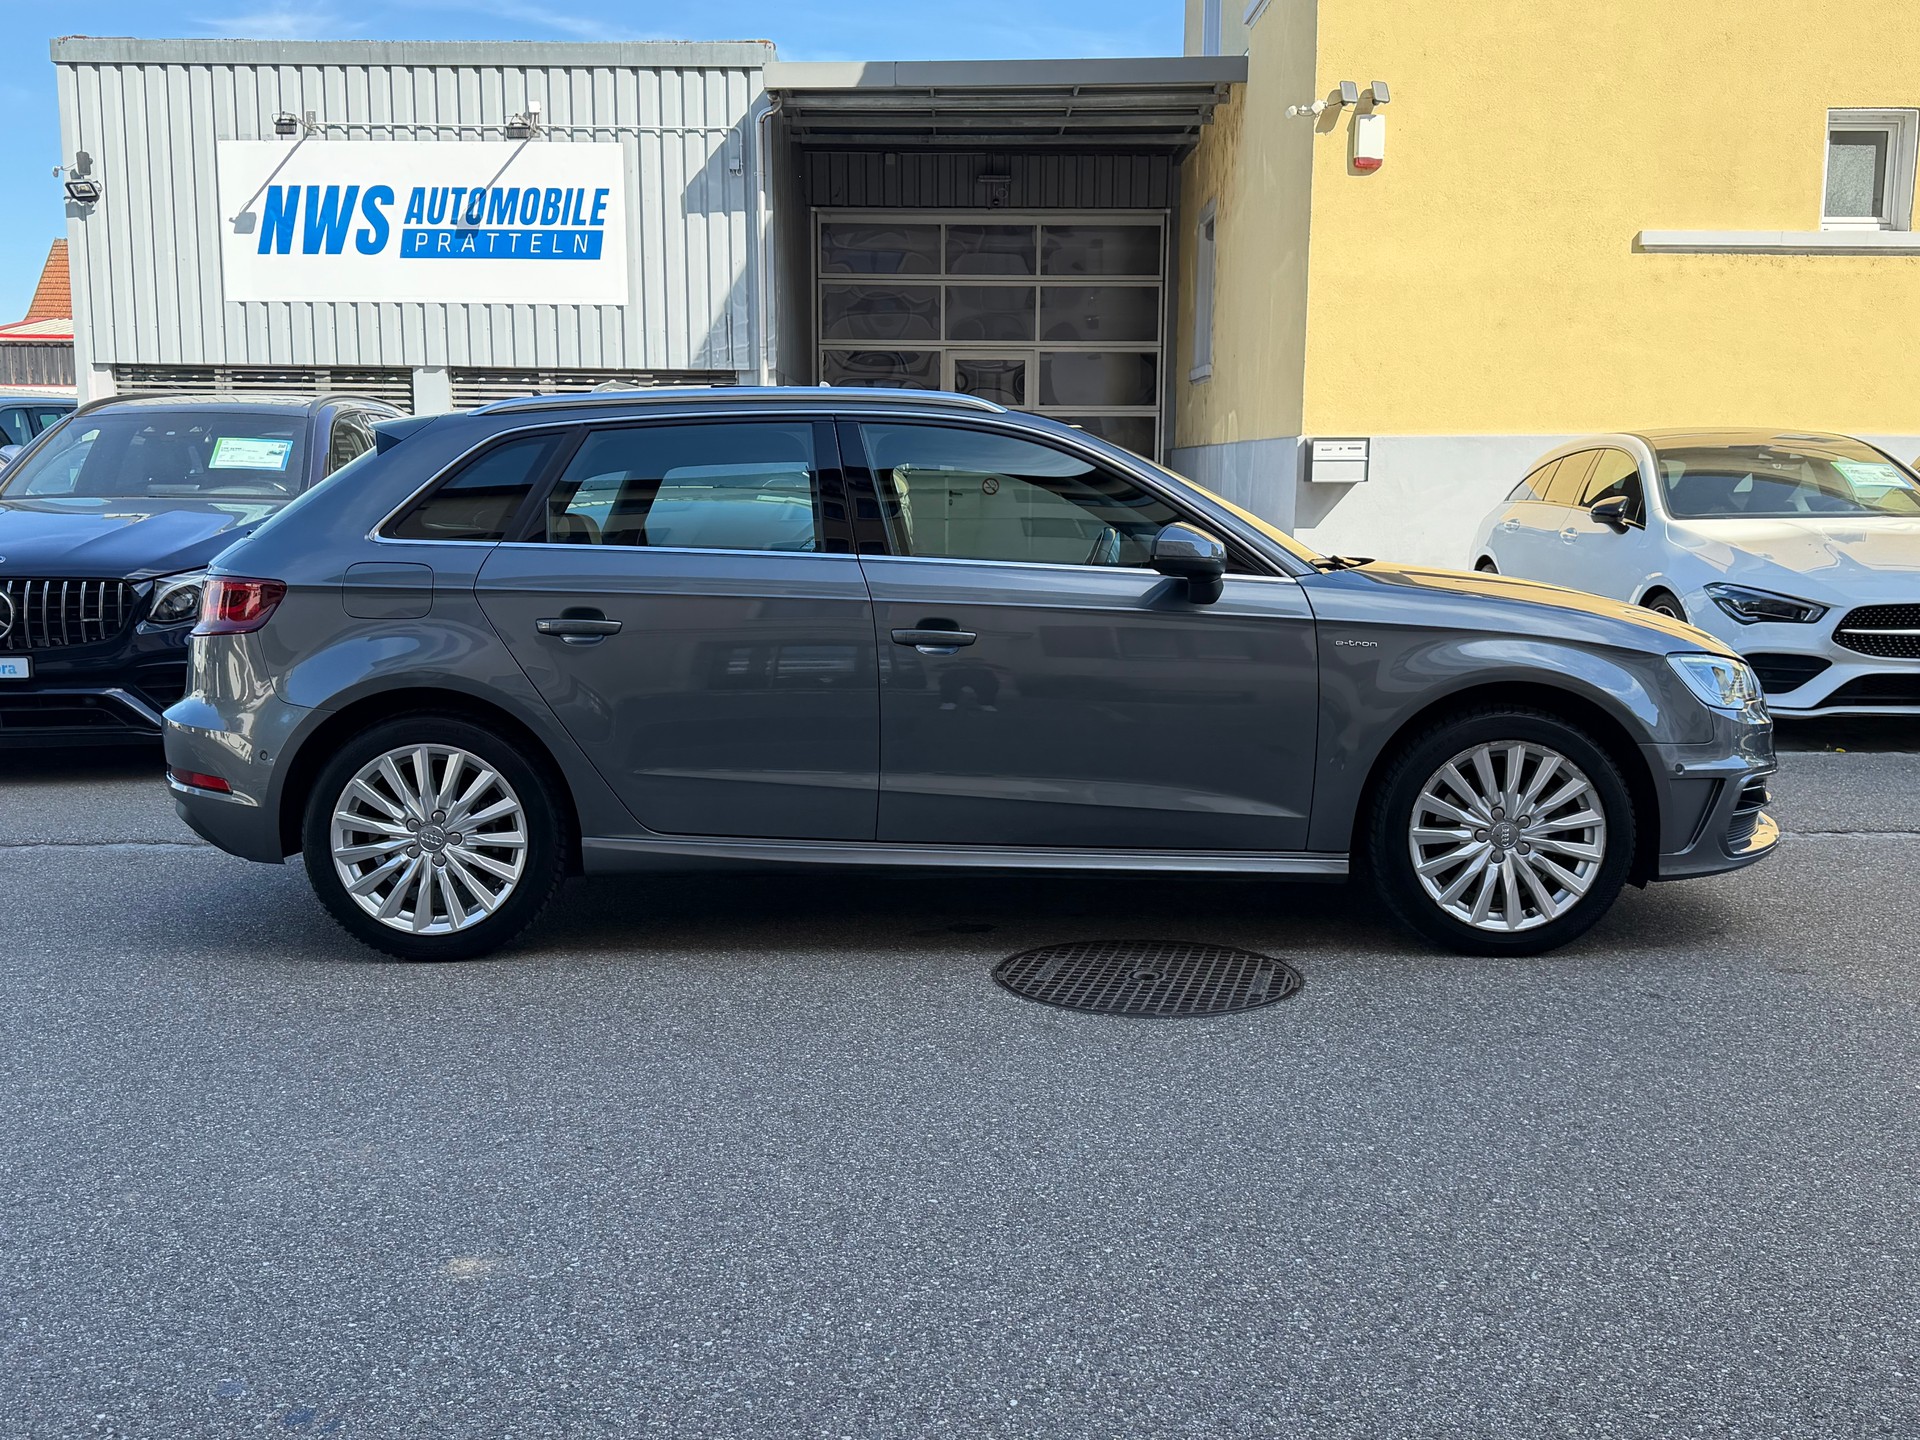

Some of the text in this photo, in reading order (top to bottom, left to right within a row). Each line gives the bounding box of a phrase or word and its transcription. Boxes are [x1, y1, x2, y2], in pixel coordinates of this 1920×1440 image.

[258, 185, 609, 255] NWS AUTOMOBILE
[414, 232, 589, 254] PRATTELN
[1335, 639, 1378, 648] e-tron
[0, 664, 17, 675] ra
